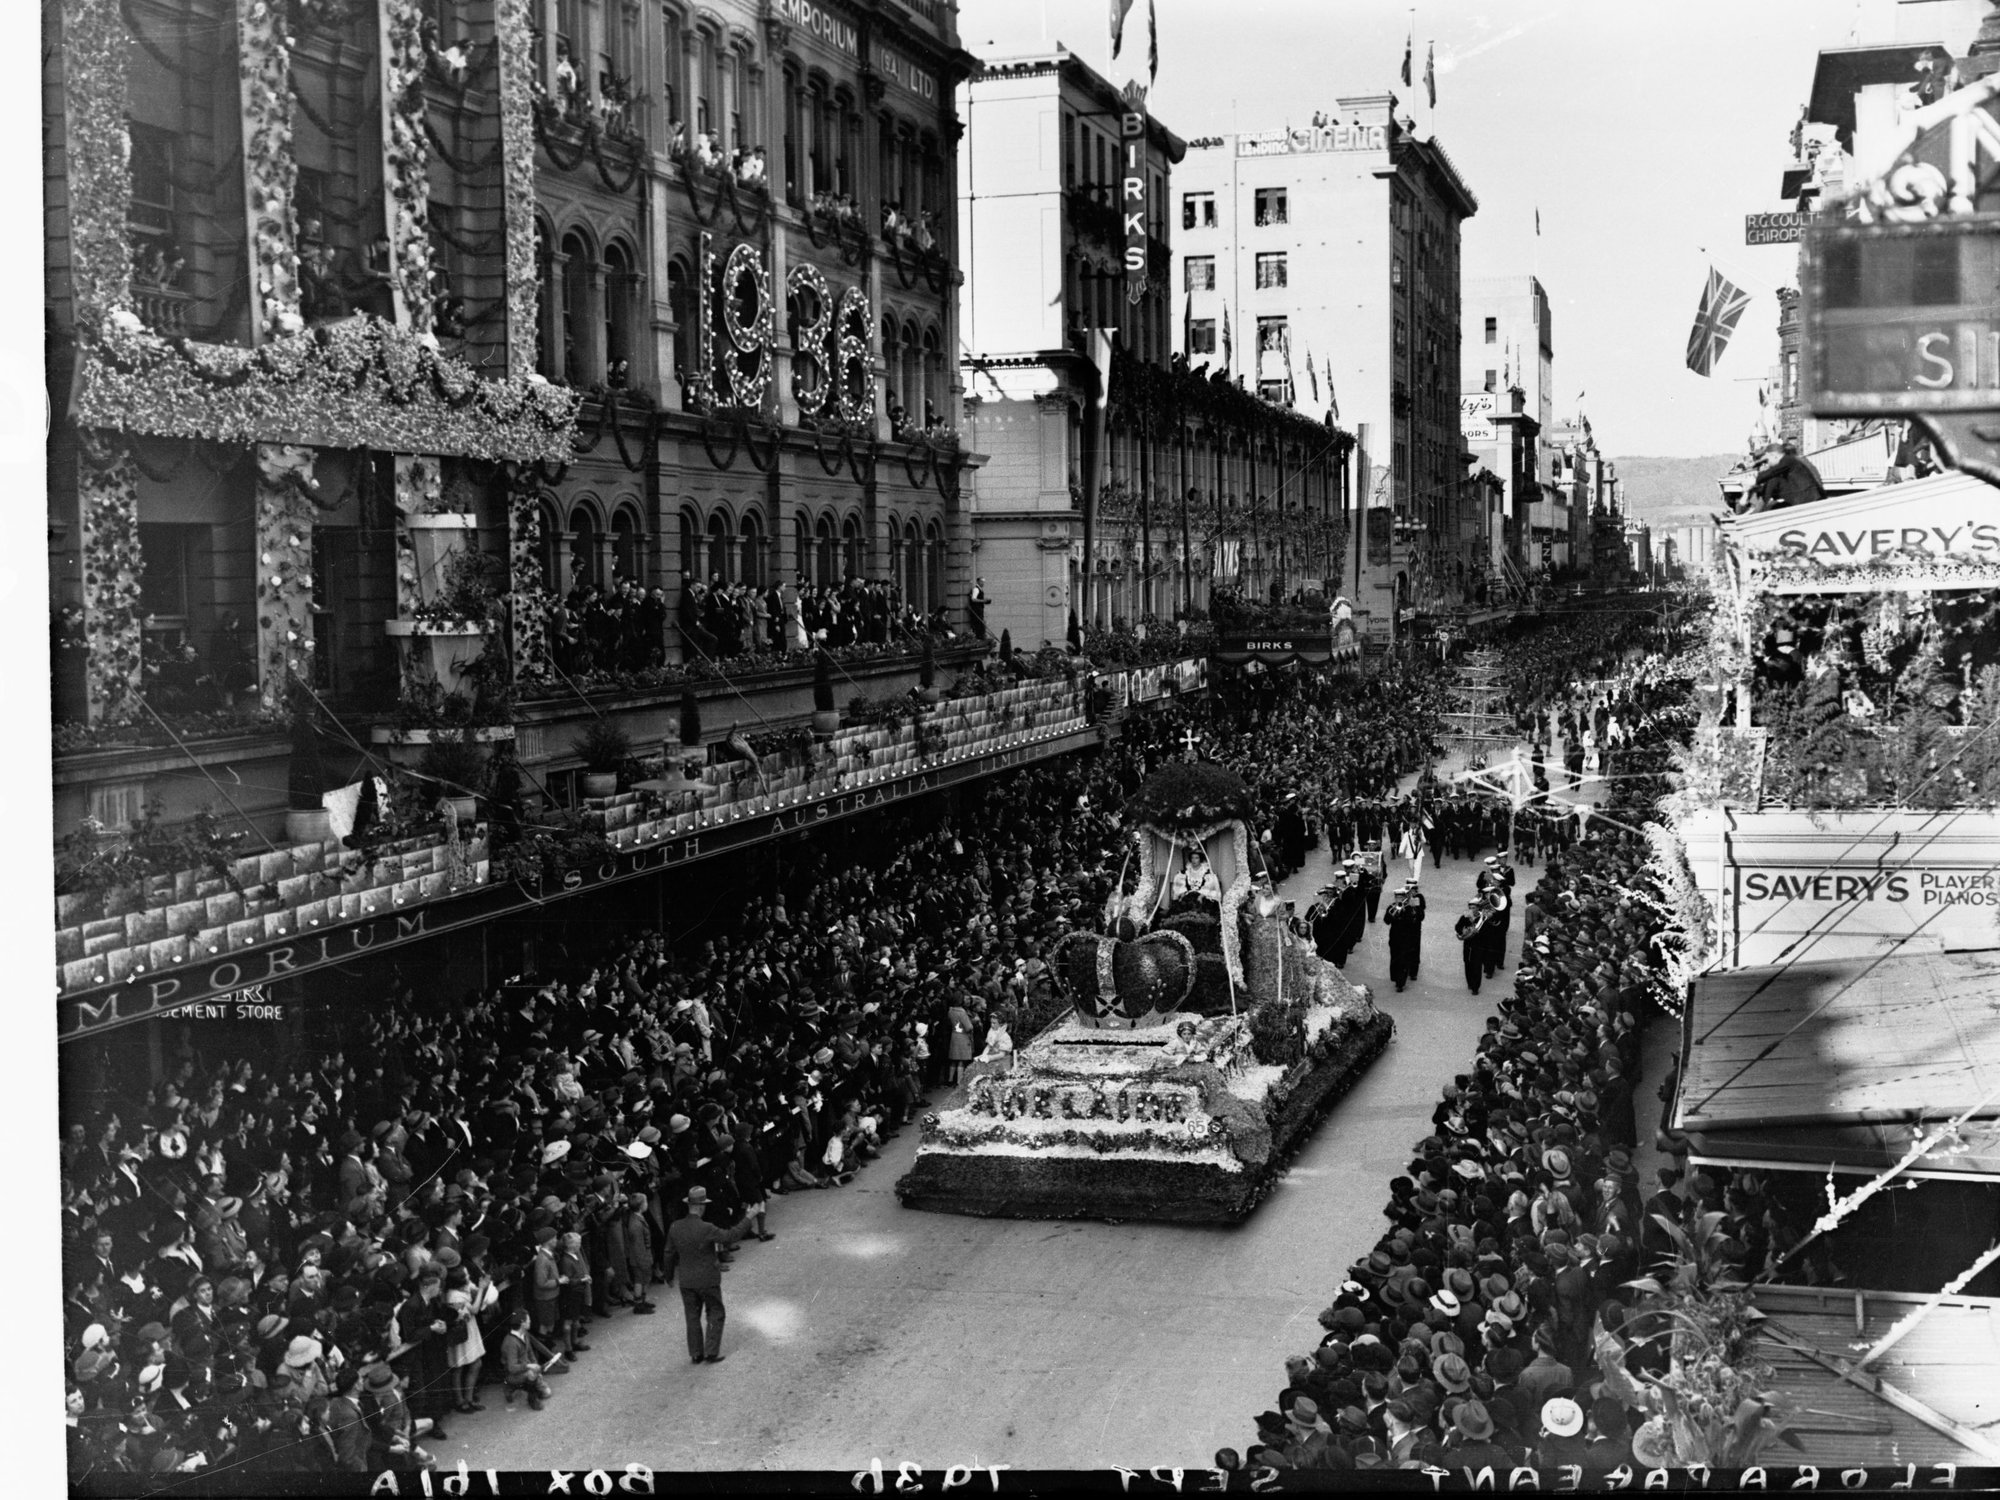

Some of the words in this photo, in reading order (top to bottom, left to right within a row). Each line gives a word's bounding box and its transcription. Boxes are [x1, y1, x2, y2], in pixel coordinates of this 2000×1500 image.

[776, 0, 857, 56] EMPORIUM
[910, 64, 934, 99] LTD
[1291, 126, 1387, 151] CINEMA
[1122, 111, 1145, 271] BIRKS
[701, 231, 878, 425] 1936
[1778, 521, 2000, 556] SAVERY'S
[1246, 642, 1293, 650] BIRKS
[1745, 872, 1910, 902] SAVERY'S
[1924, 890, 1998, 906] PIANOS
[236, 1005, 284, 1021] STORE
[1187, 1118, 1206, 1136] 65
